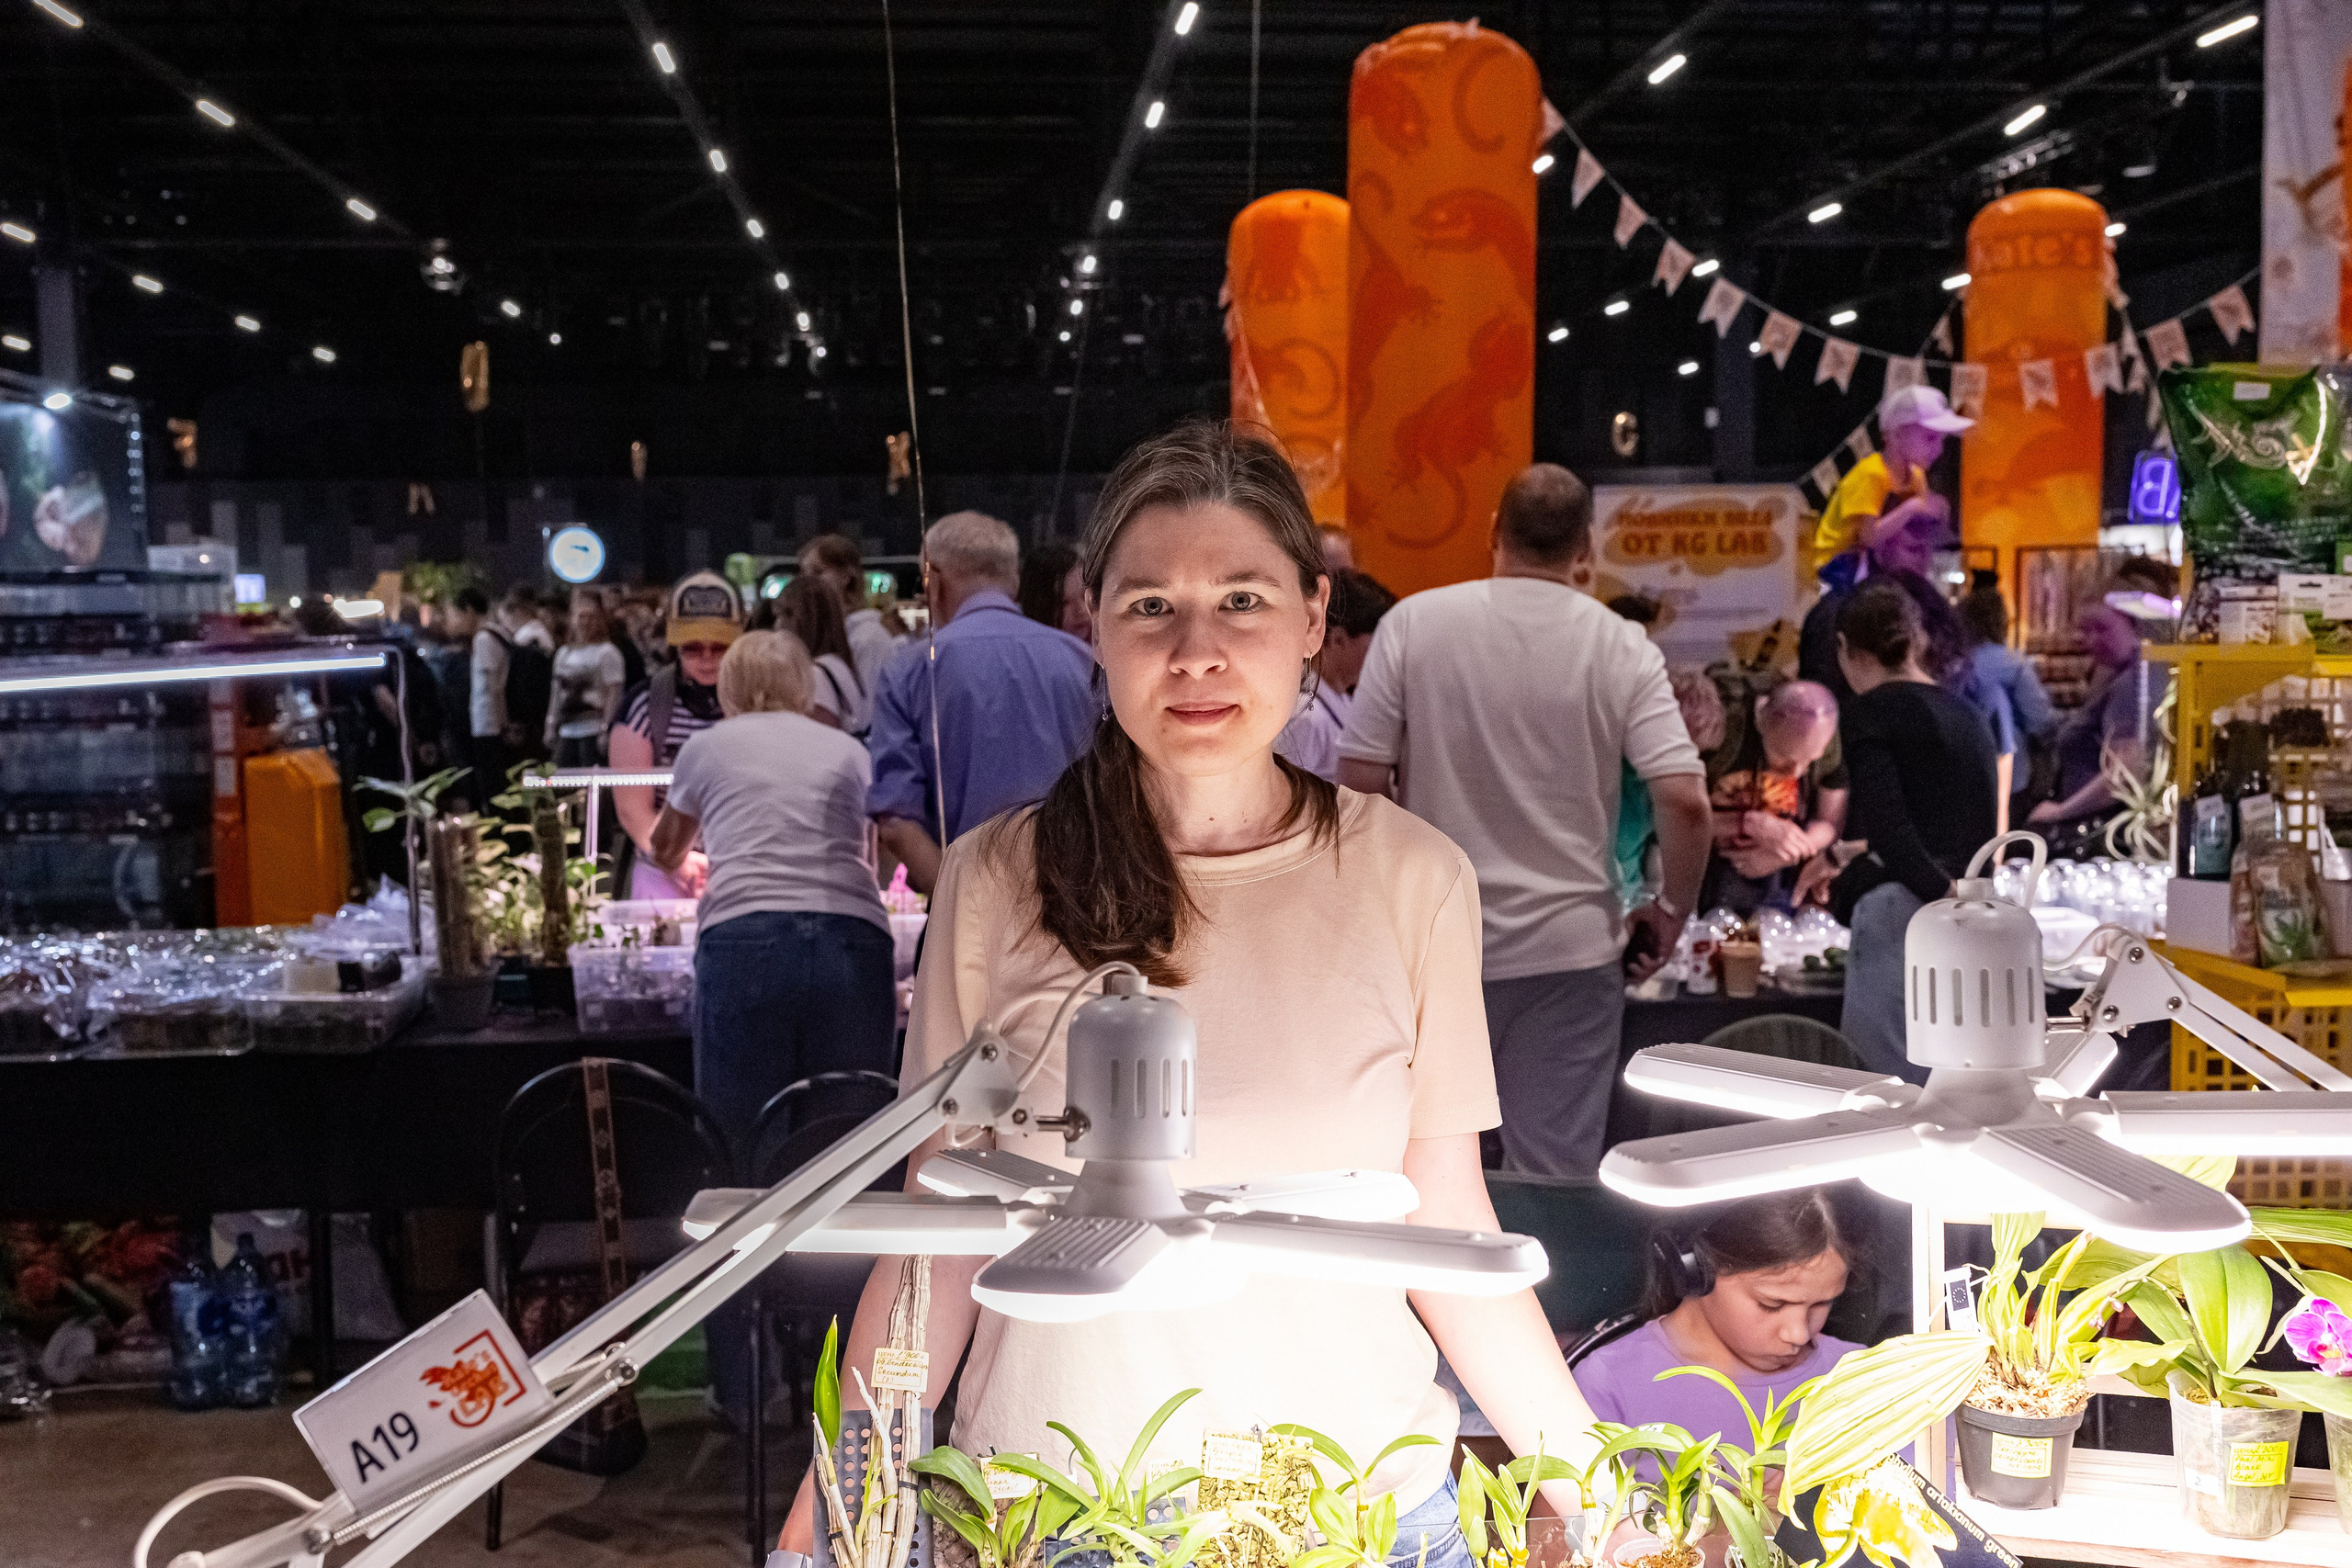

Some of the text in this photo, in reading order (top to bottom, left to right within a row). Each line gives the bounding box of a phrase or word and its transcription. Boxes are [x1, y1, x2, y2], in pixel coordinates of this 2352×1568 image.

[1623, 531, 1662, 556] ОТ
[1716, 531, 1767, 556] LAB
[351, 1412, 420, 1483] A19
[1888, 1453, 2019, 1568] phyllum artakianum green
